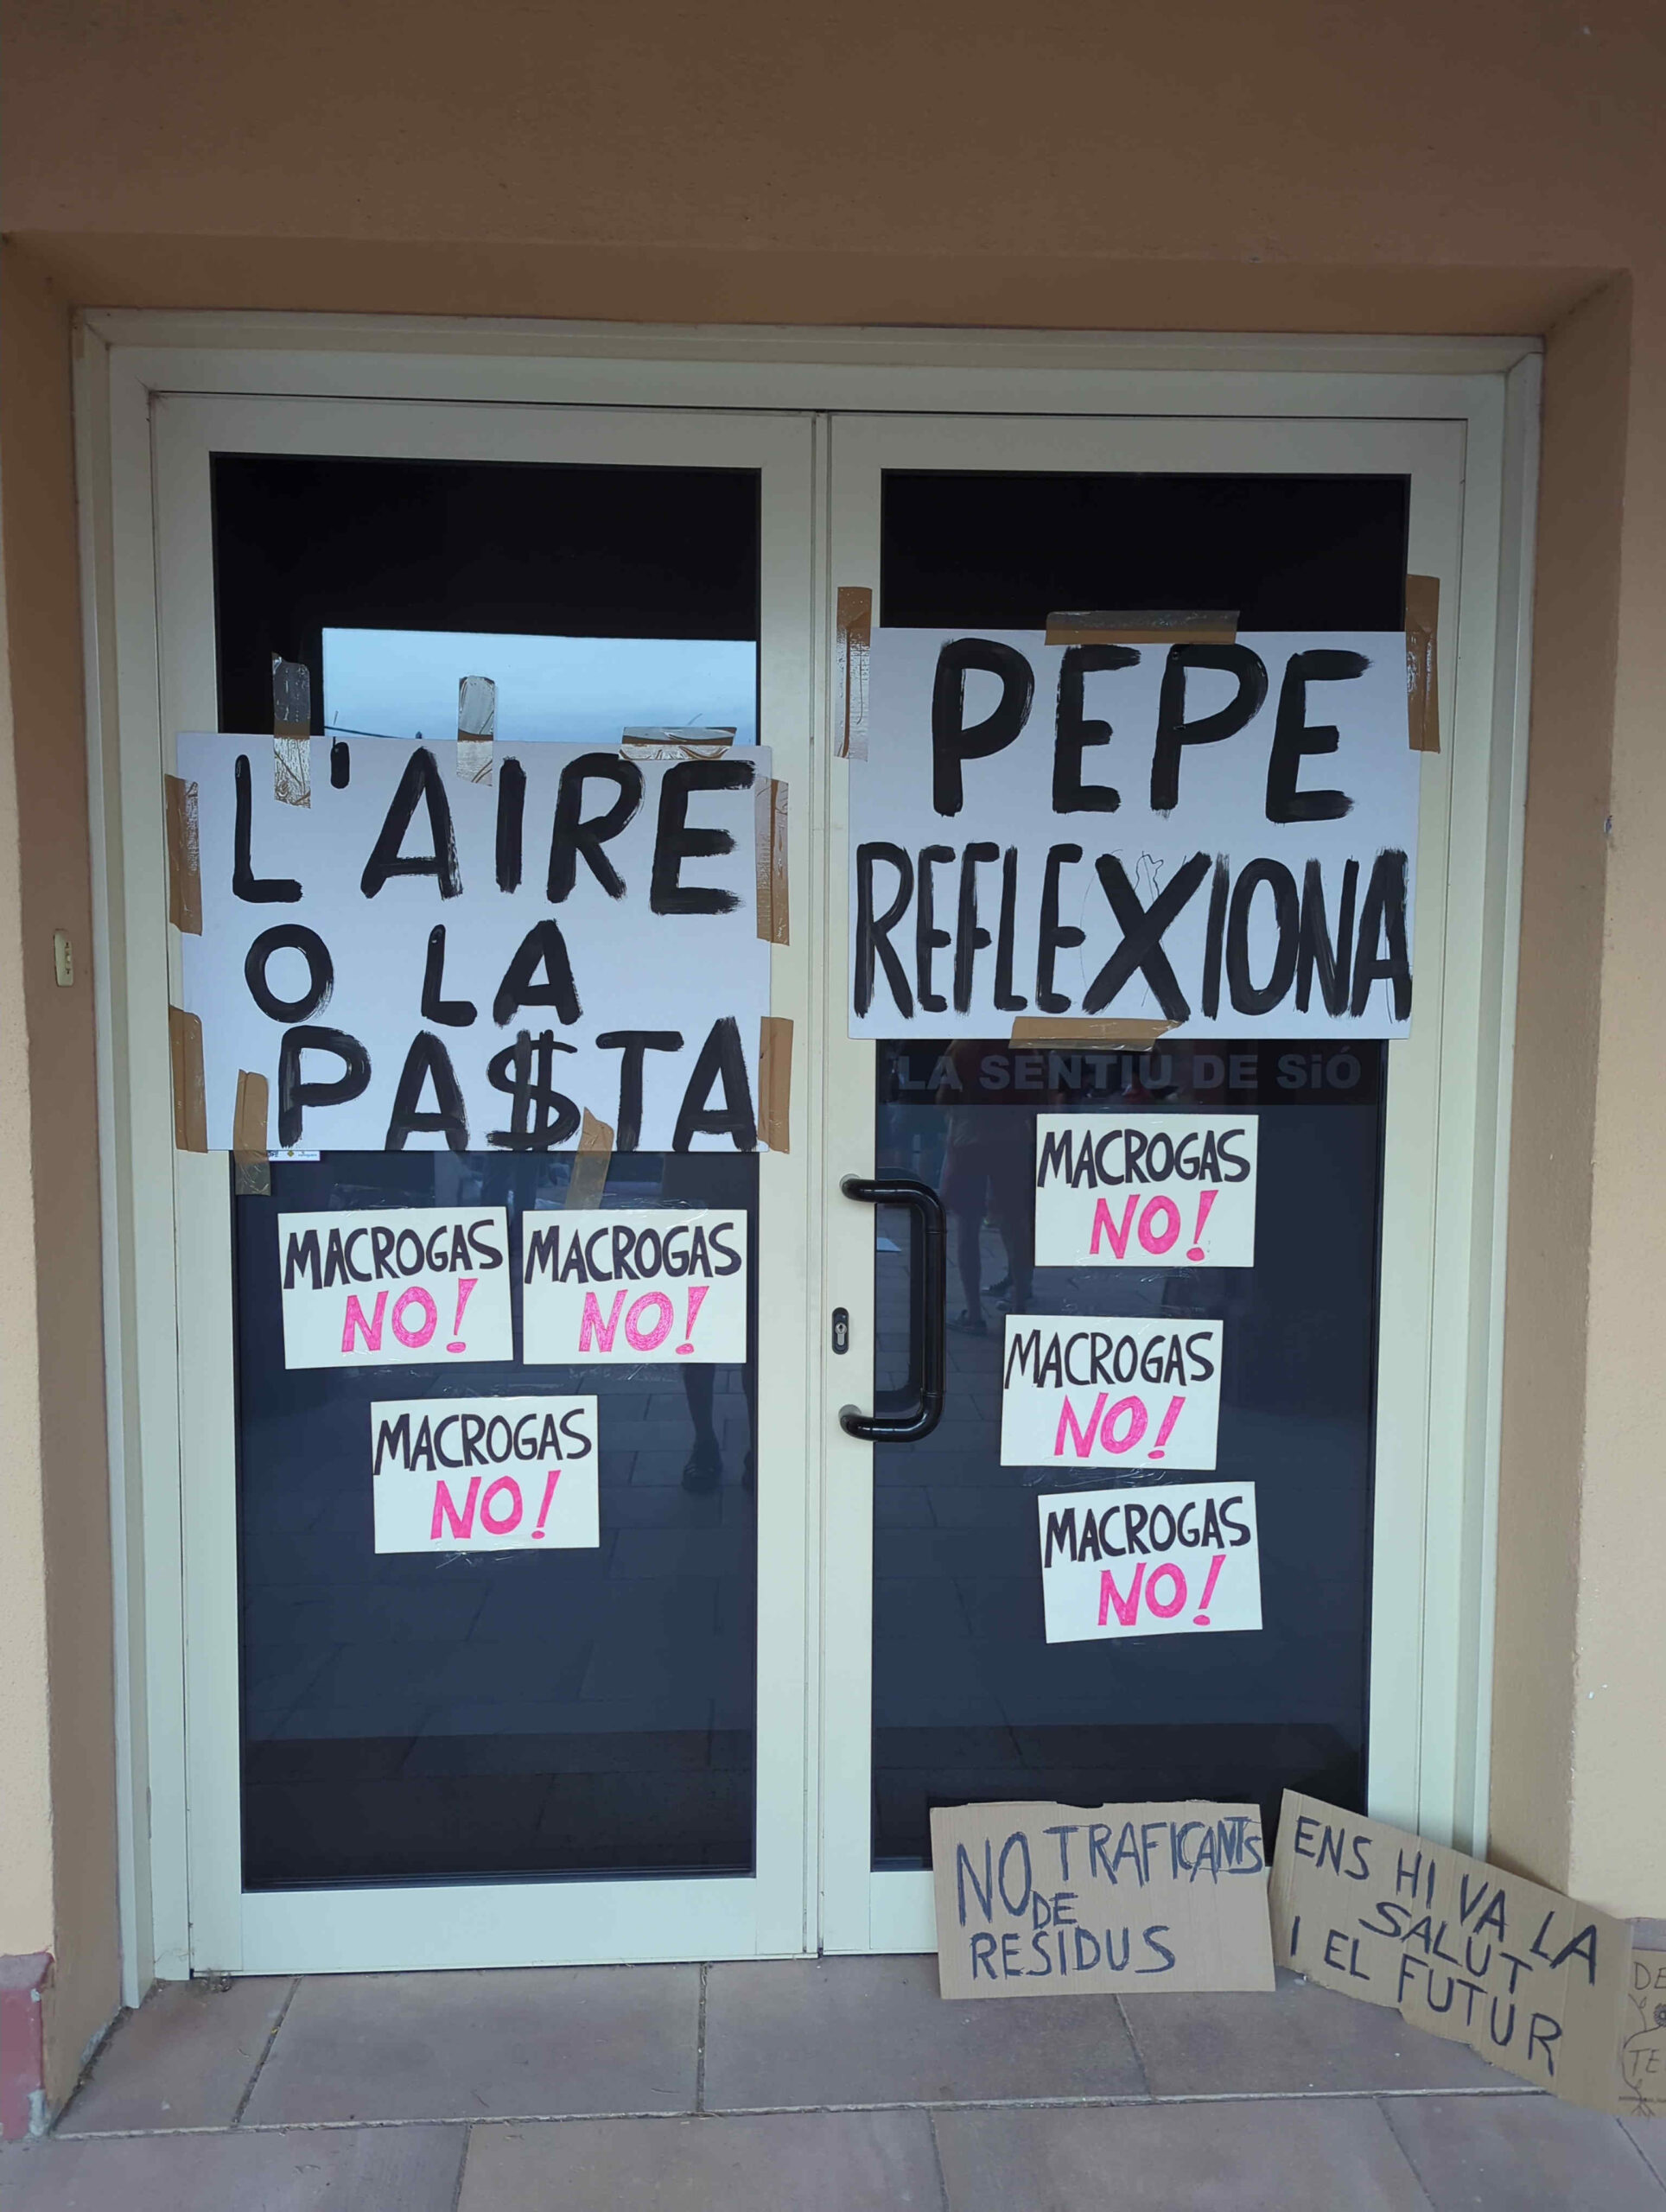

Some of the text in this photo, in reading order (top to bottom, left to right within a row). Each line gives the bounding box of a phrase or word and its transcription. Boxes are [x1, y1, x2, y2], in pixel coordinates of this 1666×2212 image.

[932, 638, 1374, 823] PEPE
[232, 741, 757, 915] L'AIRE
[853, 842, 1413, 1022] REFLEXIONA
[245, 919, 584, 1027] O LA
[277, 1016, 758, 1152] PA$TA
[898, 1055, 963, 1090] LA
[979, 1053, 1173, 1090] SENTIU
[1193, 1053, 1259, 1090] DE
[1037, 1128, 1251, 1189] MACROGAS
[283, 1219, 504, 1290] MACROGAS
[524, 1222, 743, 1285] MACROGAS
[1090, 1189, 1219, 1262] NO!
[341, 1278, 479, 1354] NO!
[578, 1285, 710, 1355] NO!
[1004, 1329, 1215, 1389] MACROGAS
[373, 1408, 593, 1476] MACROGAS
[1053, 1392, 1186, 1459] NO!
[430, 1470, 562, 1541] NO!
[1044, 1496, 1252, 1568] MACROGAS
[1098, 1554, 1227, 1626] NO!
[956, 1815, 1263, 1928] NO TRAFICANTS
[1294, 1815, 1598, 1986] ENS HI VA LA
[1032, 1891, 1078, 1931] DE
[970, 1924, 1176, 1980] RESIDUS
[1358, 1900, 1533, 1995] SALUT
[1290, 1915, 1563, 2077] I EL FUTUR
